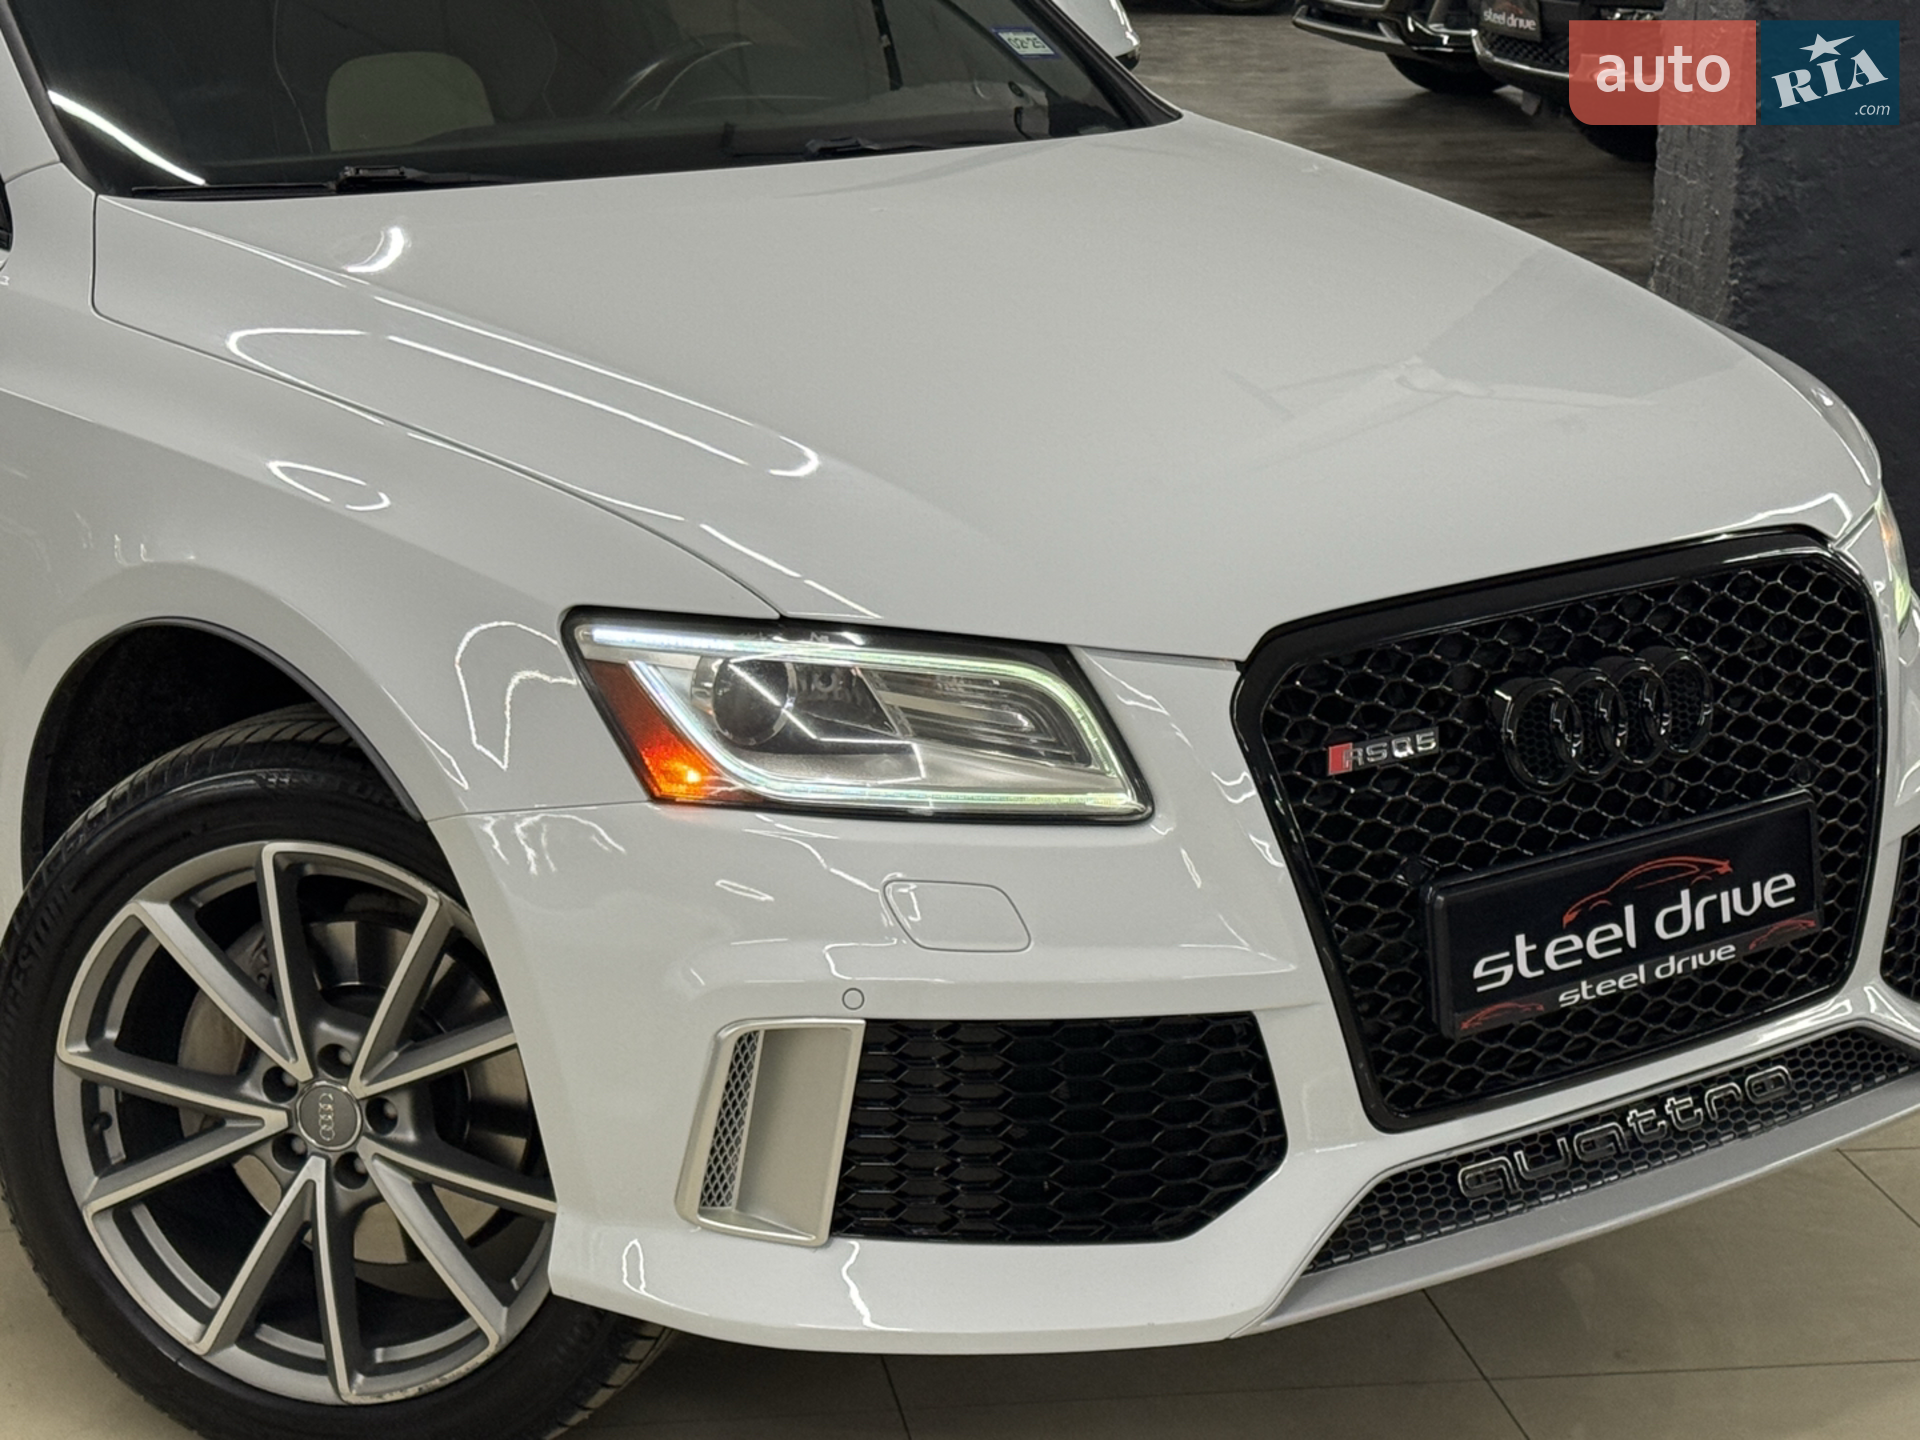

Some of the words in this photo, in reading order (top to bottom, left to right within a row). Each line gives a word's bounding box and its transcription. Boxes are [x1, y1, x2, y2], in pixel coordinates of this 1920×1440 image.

[1507, 13, 1537, 31] drive
[1341, 731, 1437, 769] RSQ5
[1474, 905, 1636, 992] steel
[1655, 873, 1797, 940] drive
[1558, 967, 1647, 1009] steel
[1654, 943, 1737, 978] drive
[1457, 1064, 1792, 1199] quattro
